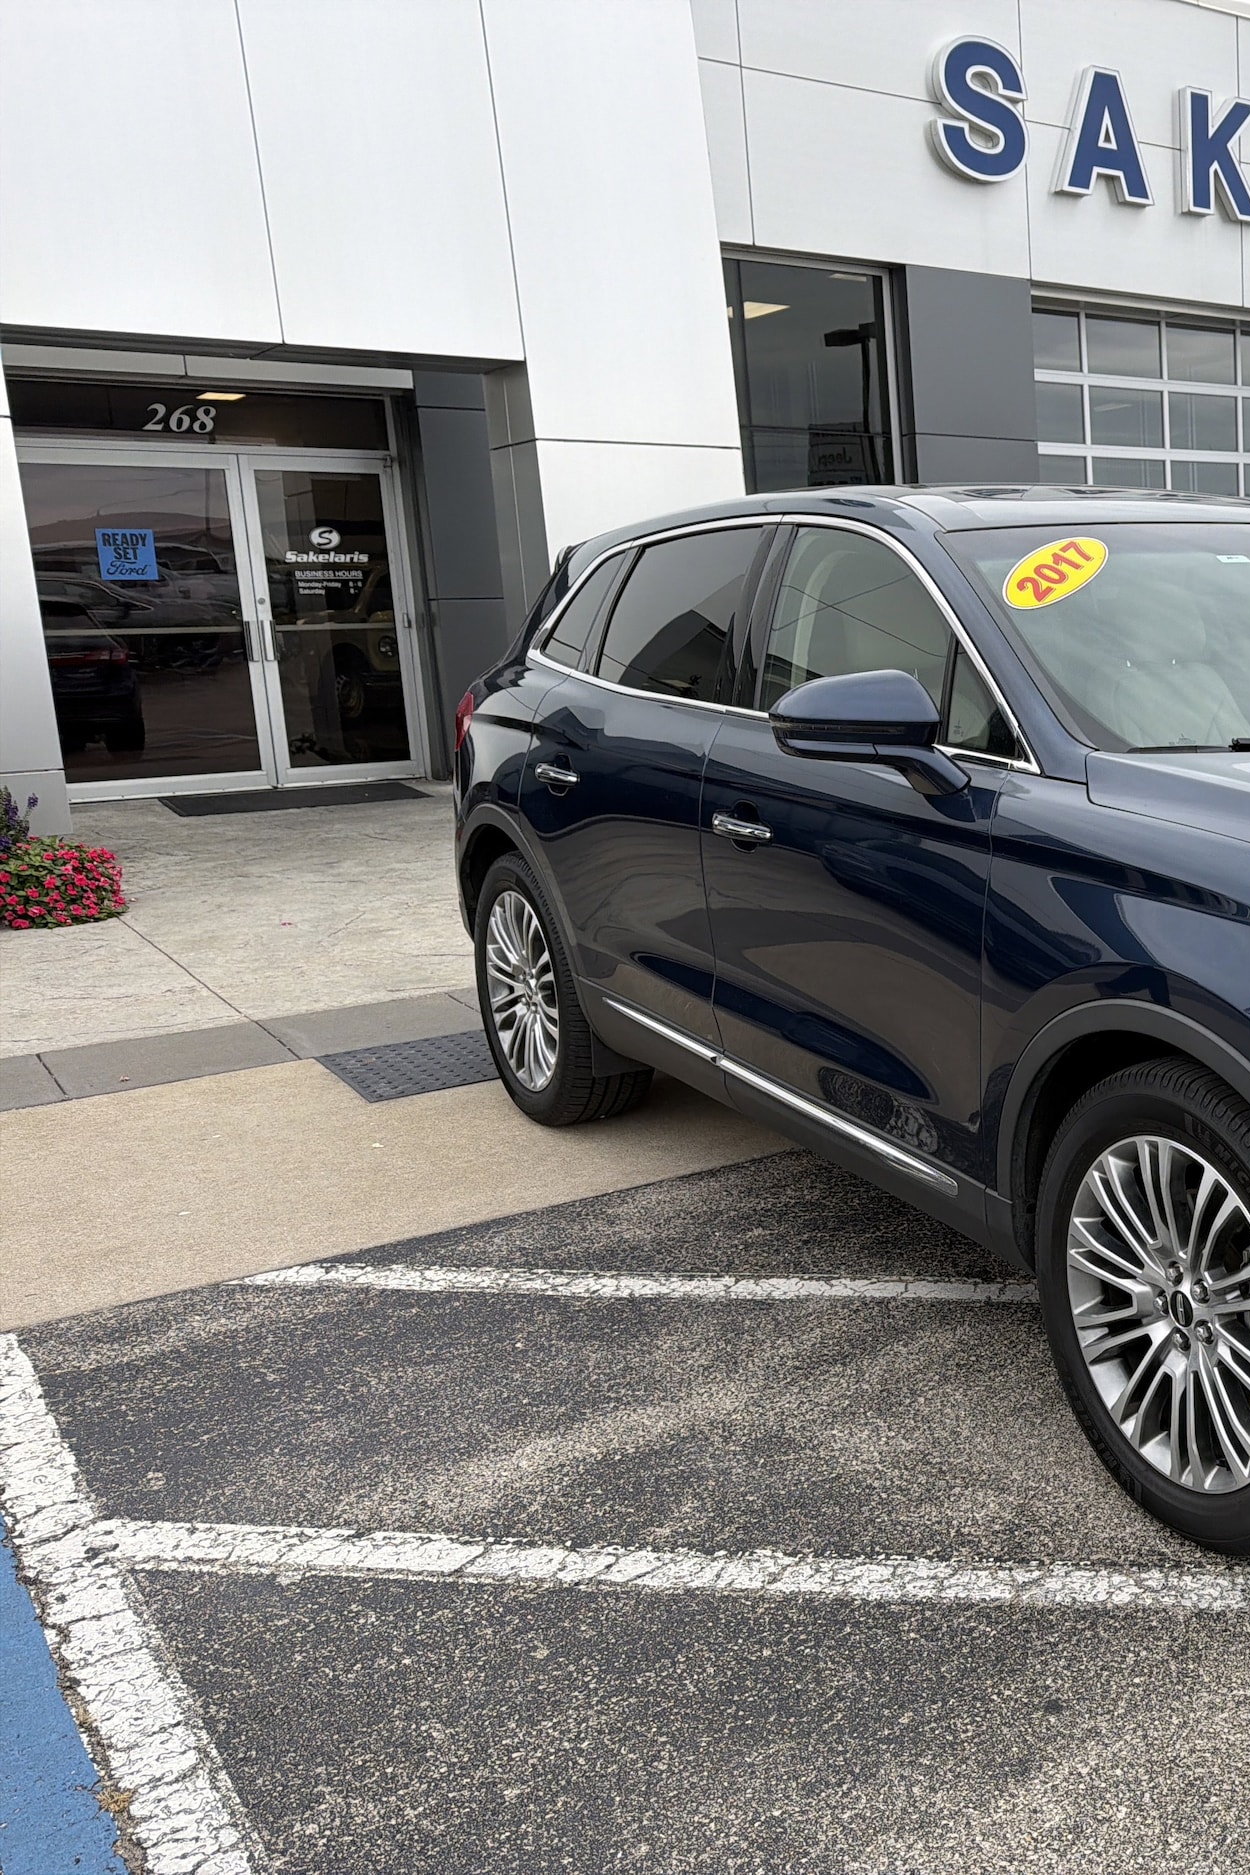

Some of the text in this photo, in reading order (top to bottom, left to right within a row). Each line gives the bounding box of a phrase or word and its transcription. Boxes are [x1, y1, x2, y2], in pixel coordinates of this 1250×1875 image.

[142, 402, 217, 434] 268
[101, 533, 148, 547] READY
[114, 547, 139, 561] SET
[285, 551, 369, 563] Sakelaris
[106, 560, 152, 576] Ford
[295, 570, 363, 579] BUSINESS HOURS
[1016, 540, 1094, 603] 2017
[298, 581, 342, 589] Monday-Friday
